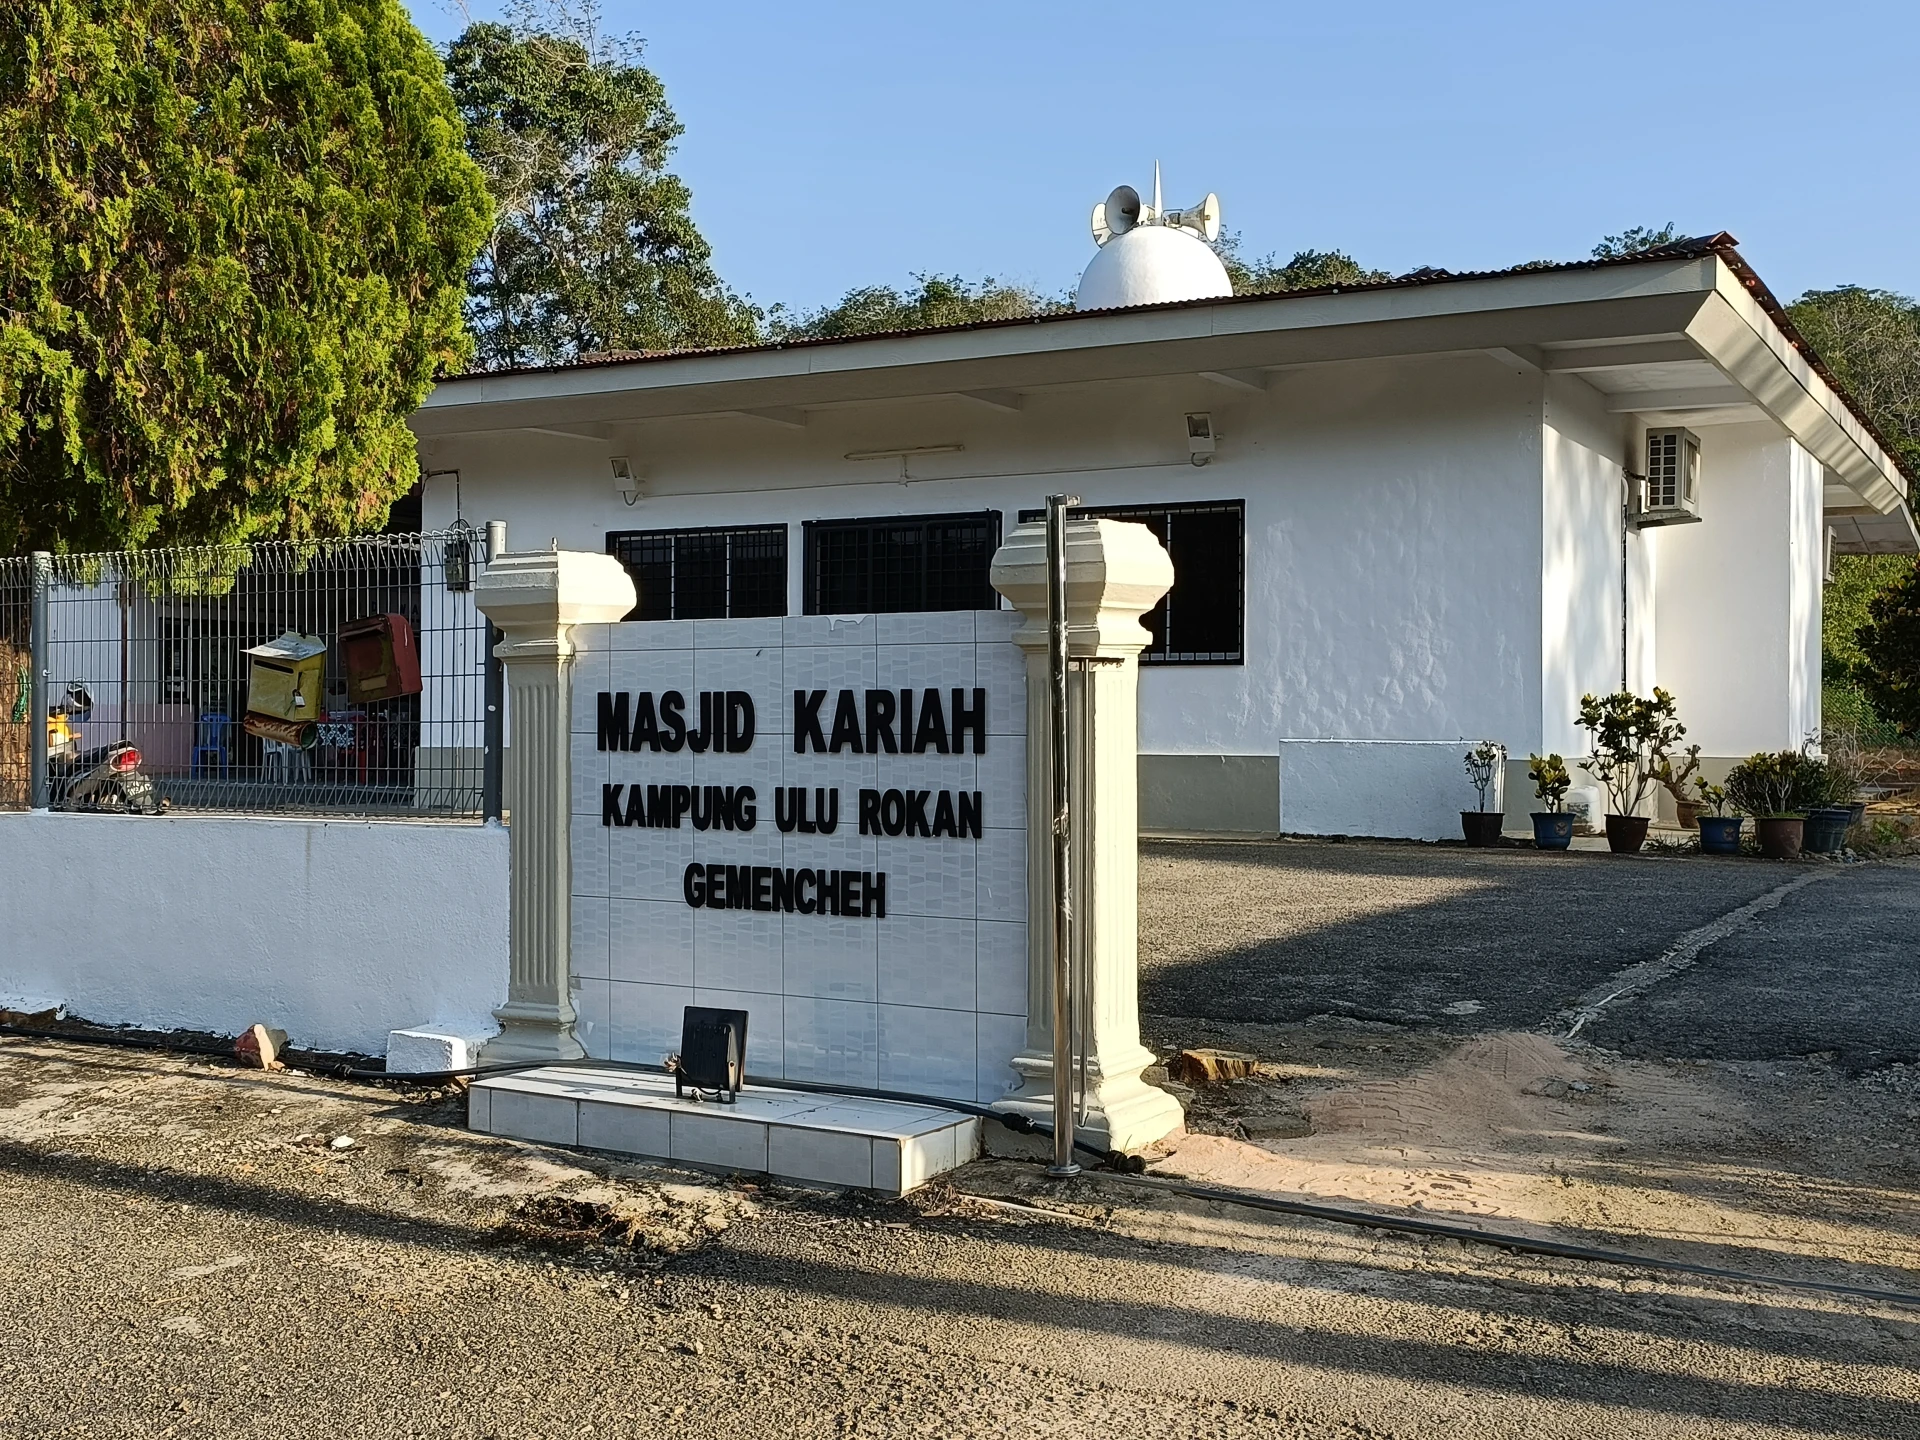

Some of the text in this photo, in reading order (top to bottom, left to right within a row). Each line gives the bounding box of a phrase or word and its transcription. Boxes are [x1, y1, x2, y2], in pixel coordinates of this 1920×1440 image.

[597, 688, 986, 754] MASJID KARIAH
[602, 783, 982, 839] KAMPUNG ULU ROKAN
[683, 862, 886, 918] GEMENCHEH
